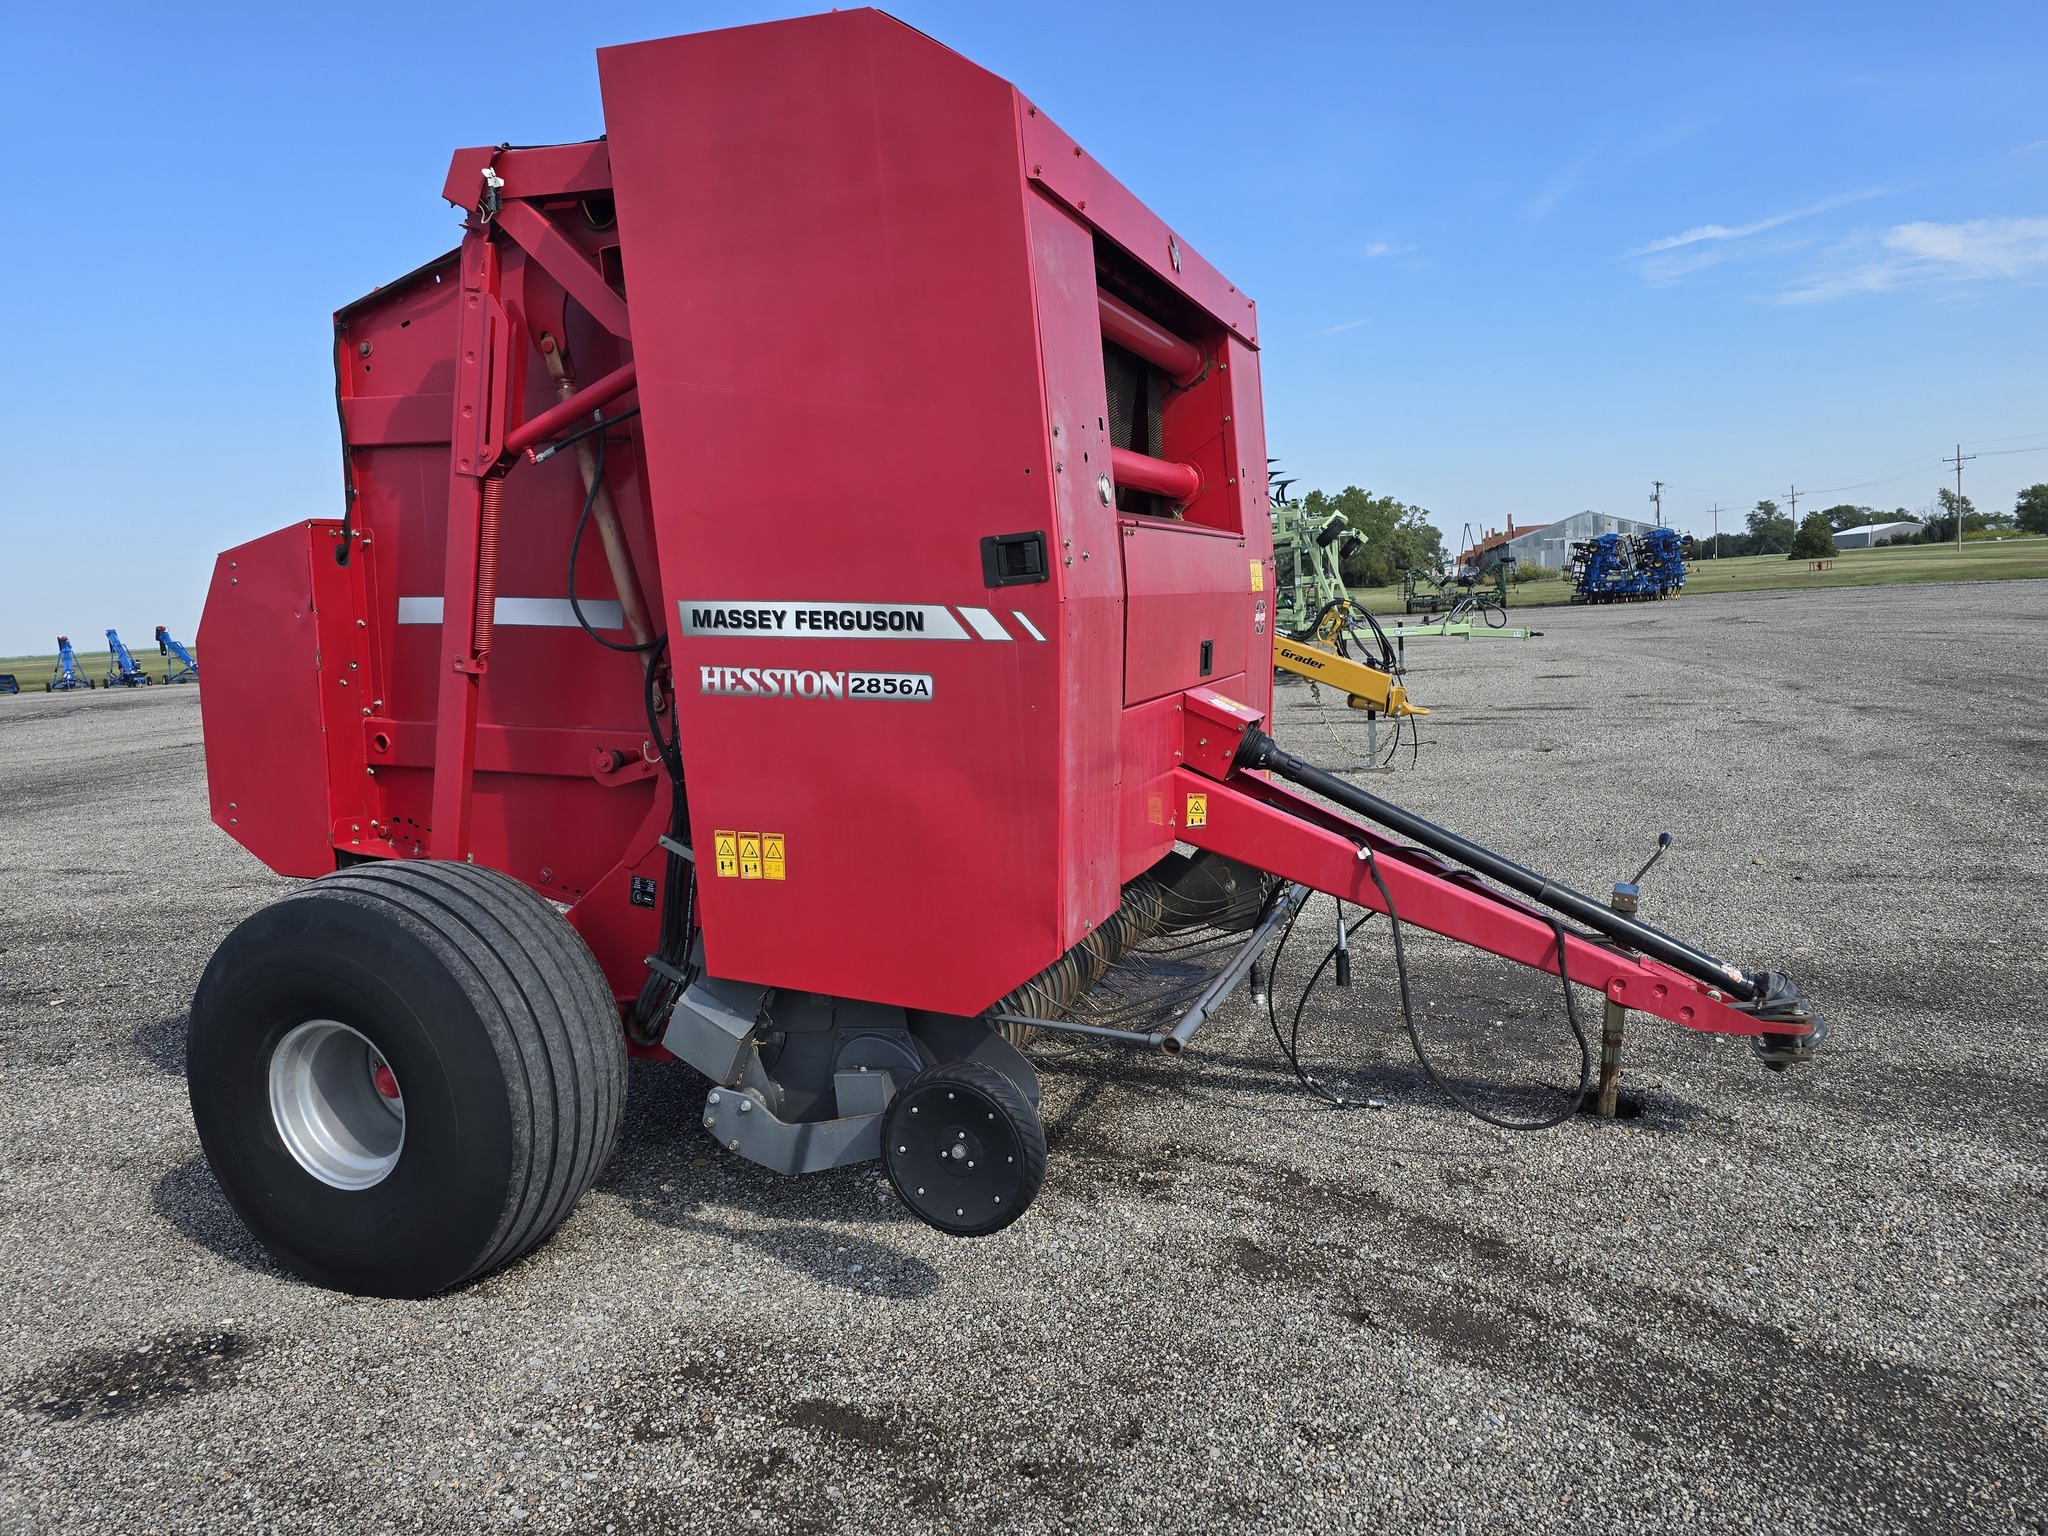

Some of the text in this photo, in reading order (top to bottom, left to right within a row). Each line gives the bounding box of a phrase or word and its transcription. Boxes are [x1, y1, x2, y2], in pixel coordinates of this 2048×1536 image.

[692, 609, 925, 632] MASSEY FERGUSON
[1280, 648, 1326, 669] Grader
[700, 665, 929, 700] HESSTON 2856A
